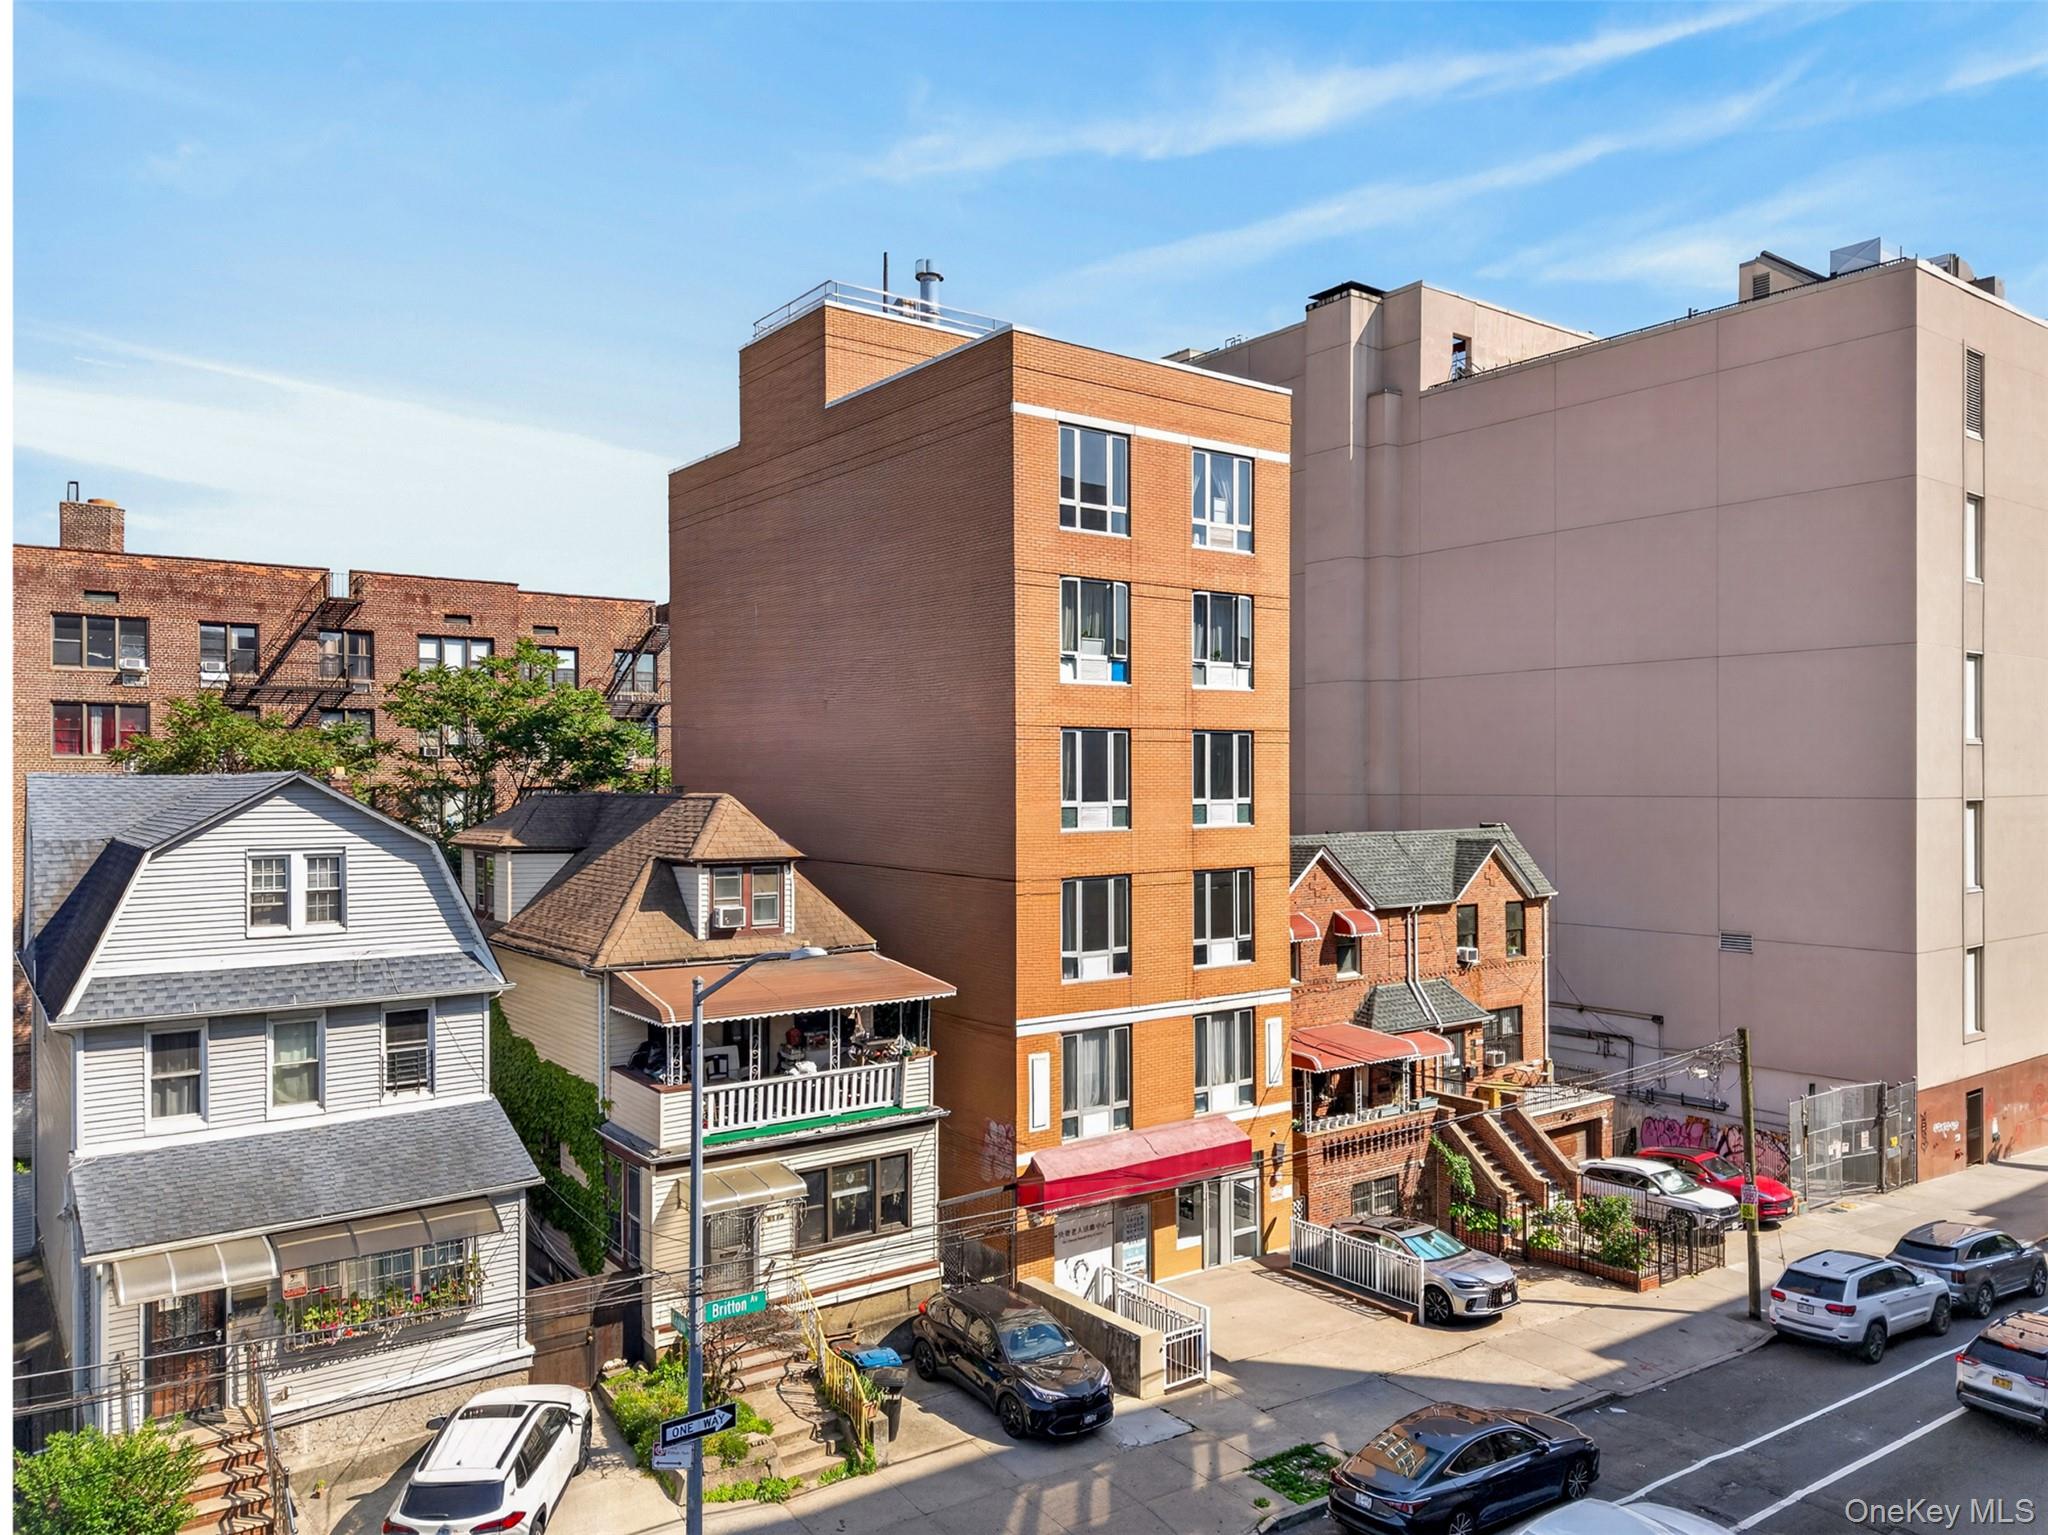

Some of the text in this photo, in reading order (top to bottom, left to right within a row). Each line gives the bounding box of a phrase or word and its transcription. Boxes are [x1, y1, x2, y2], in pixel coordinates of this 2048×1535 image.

[712, 1294, 758, 1318] Britton Av
[672, 1413, 726, 1438] ONE WAY
